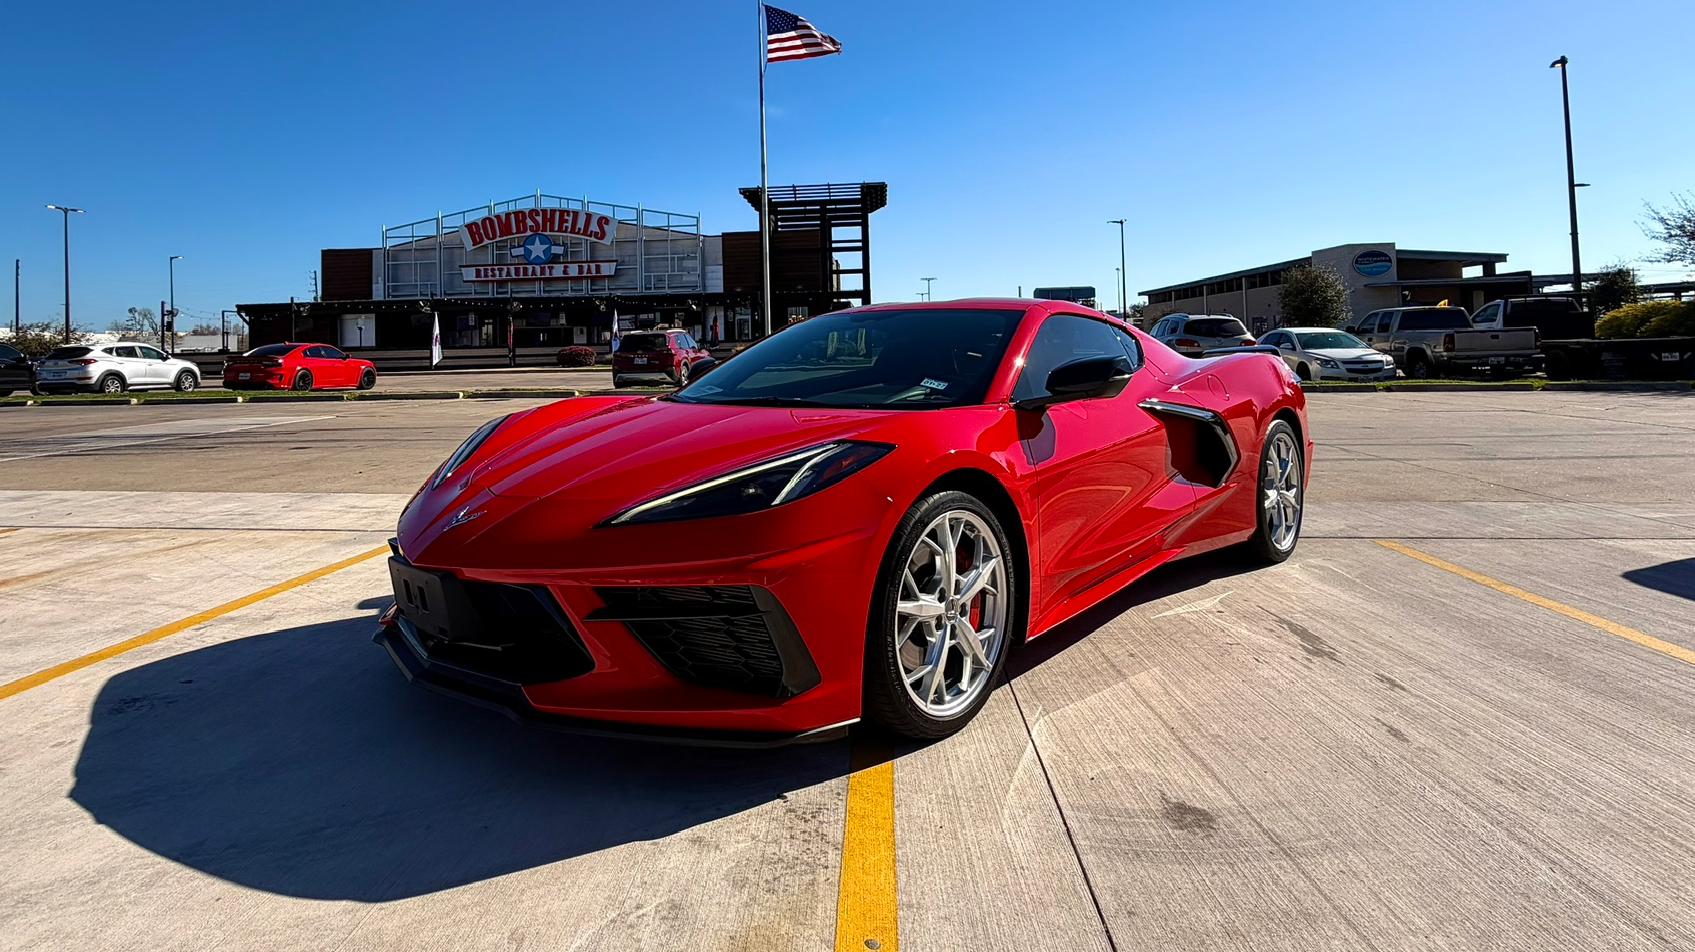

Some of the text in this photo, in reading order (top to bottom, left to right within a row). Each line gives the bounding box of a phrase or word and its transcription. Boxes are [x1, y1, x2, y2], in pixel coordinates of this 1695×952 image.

[465, 208, 610, 247] BOMBSHELLS
[475, 263, 602, 278] RESTAURANT & BAR
